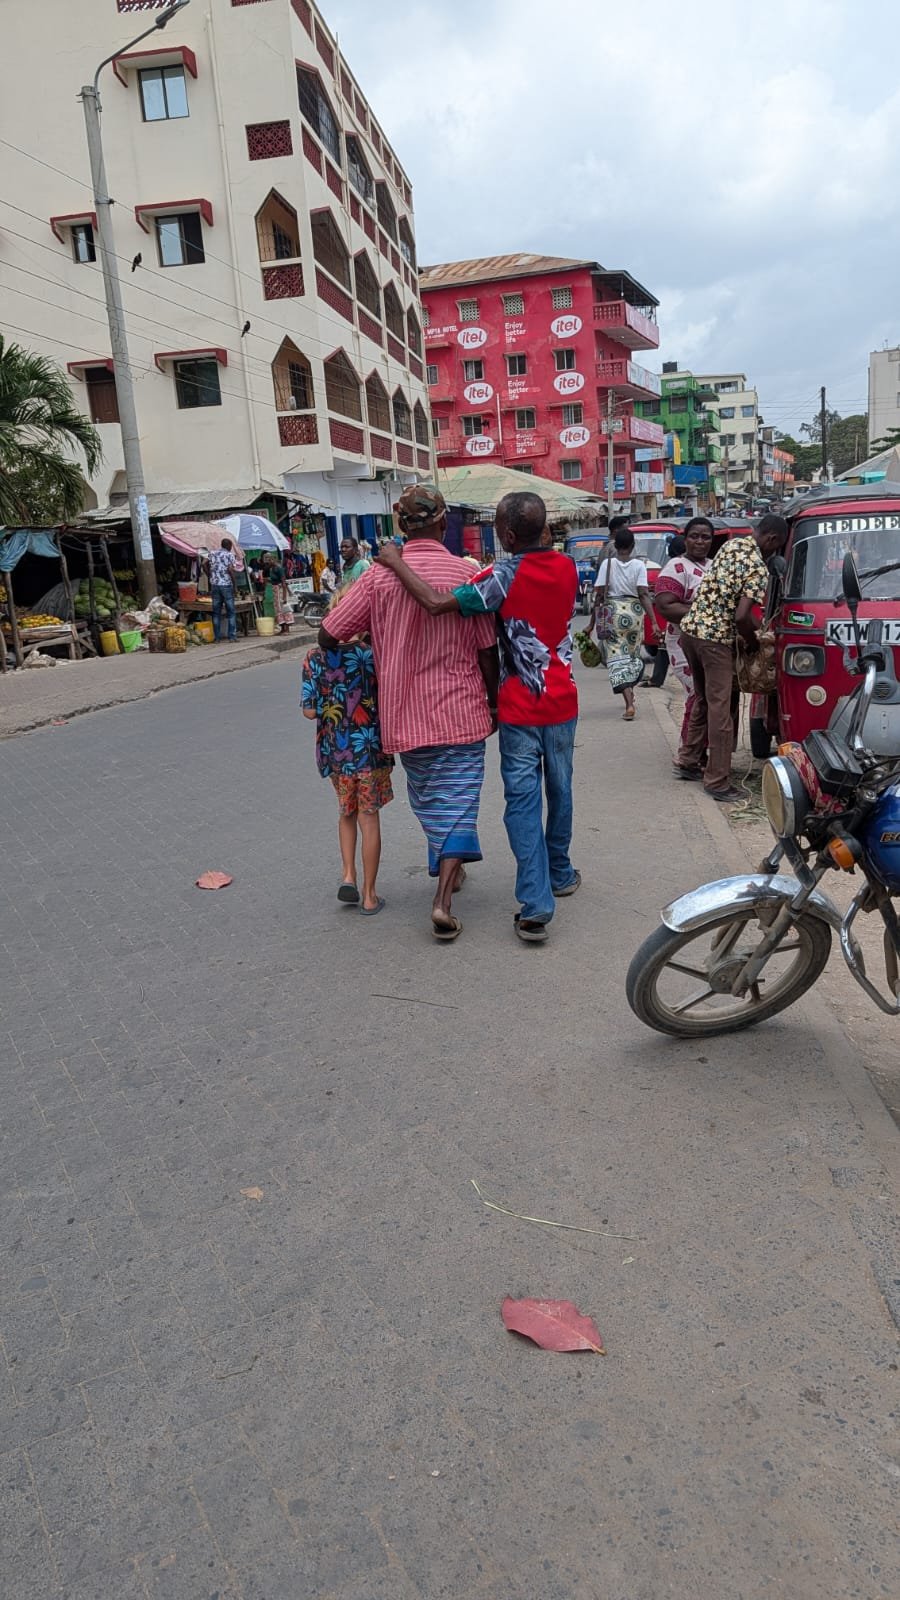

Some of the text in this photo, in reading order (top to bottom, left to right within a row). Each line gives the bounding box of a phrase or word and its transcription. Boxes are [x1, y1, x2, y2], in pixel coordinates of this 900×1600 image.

[505, 322, 523, 331] Enjoy
[557, 318, 578, 333] itel
[462, 330, 483, 344] itel
[505, 329, 526, 337] better
[506, 336, 516, 344] life
[508, 380, 526, 389] Enjoy
[559, 375, 580, 390] itel
[468, 386, 490, 399] itel
[508, 387, 529, 396] better
[564, 432, 586, 443] itel
[470, 440, 491, 452] itel
